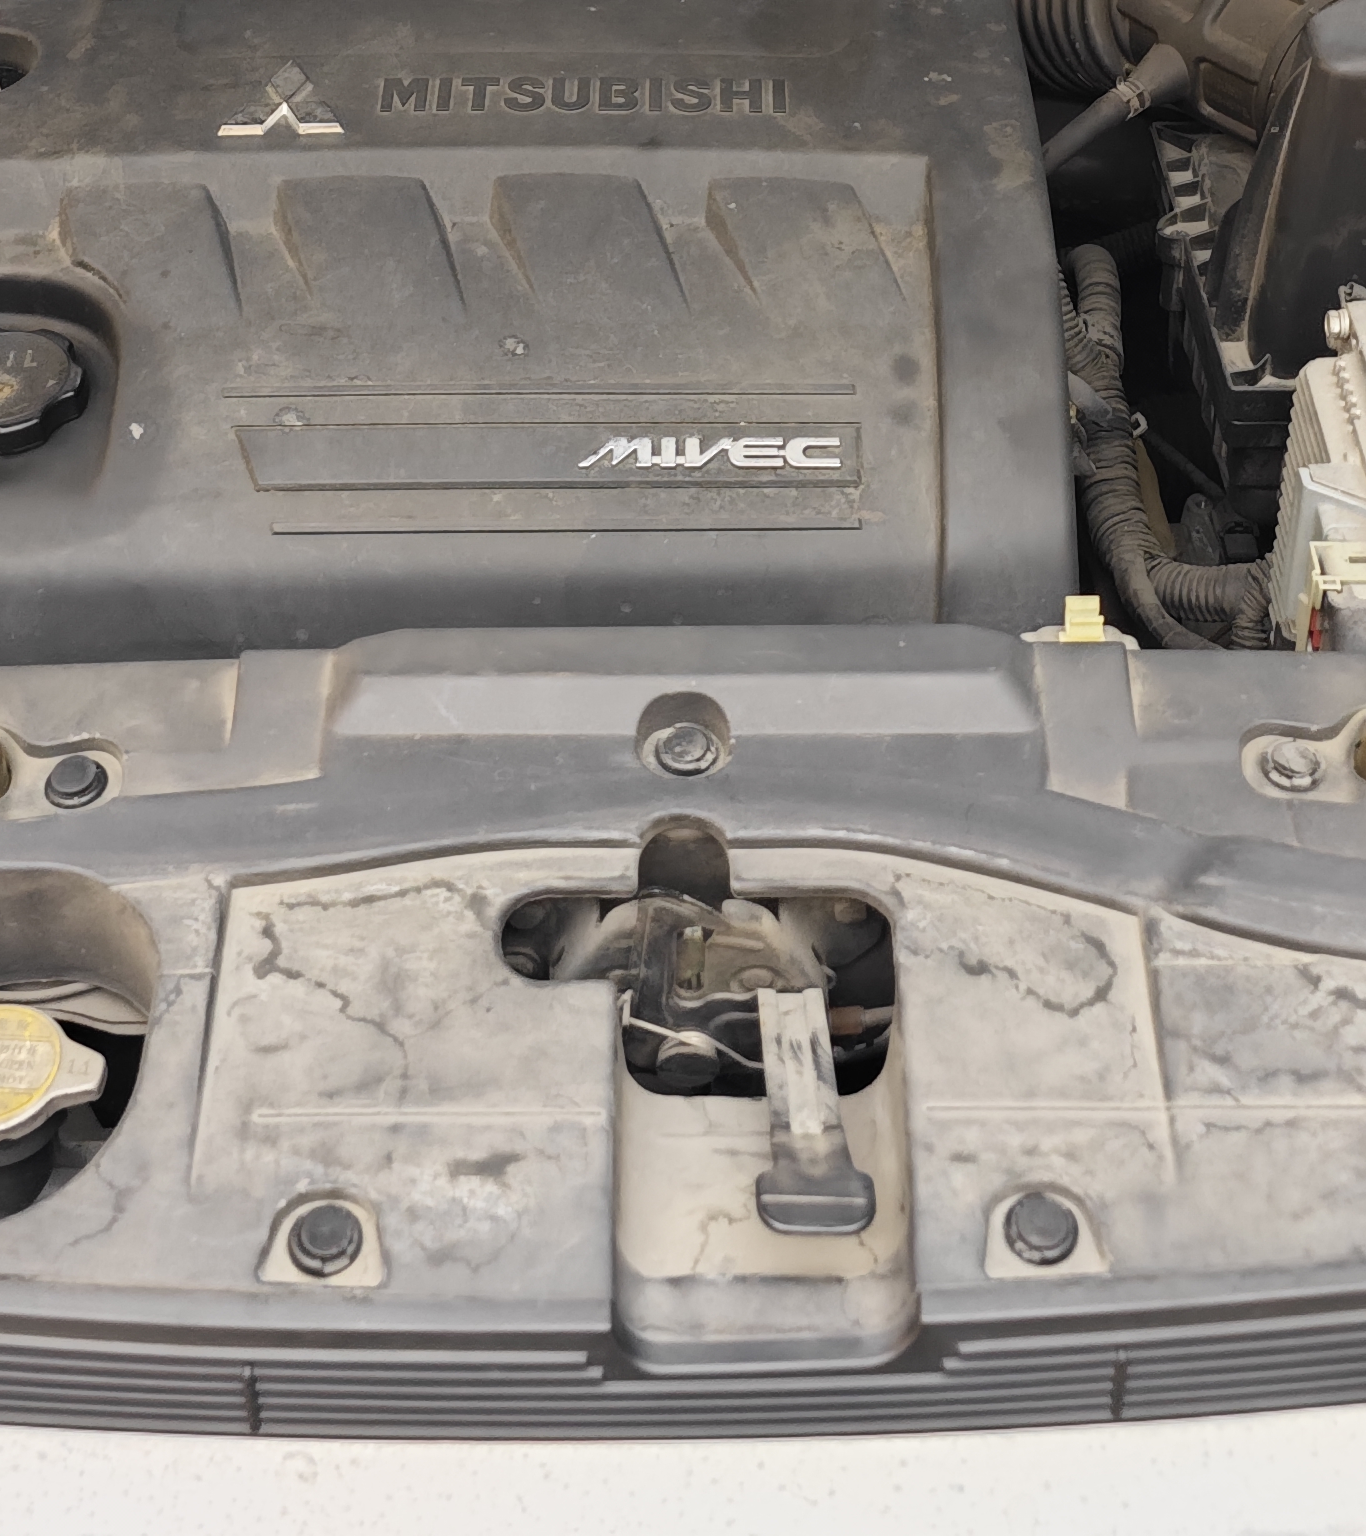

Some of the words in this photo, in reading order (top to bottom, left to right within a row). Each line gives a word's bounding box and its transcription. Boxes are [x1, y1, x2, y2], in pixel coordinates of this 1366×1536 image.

[379, 76, 787, 114] MITSUBISHI
[578, 437, 841, 467] MIVEC
[0, 1058, 36, 1072] OPEN
